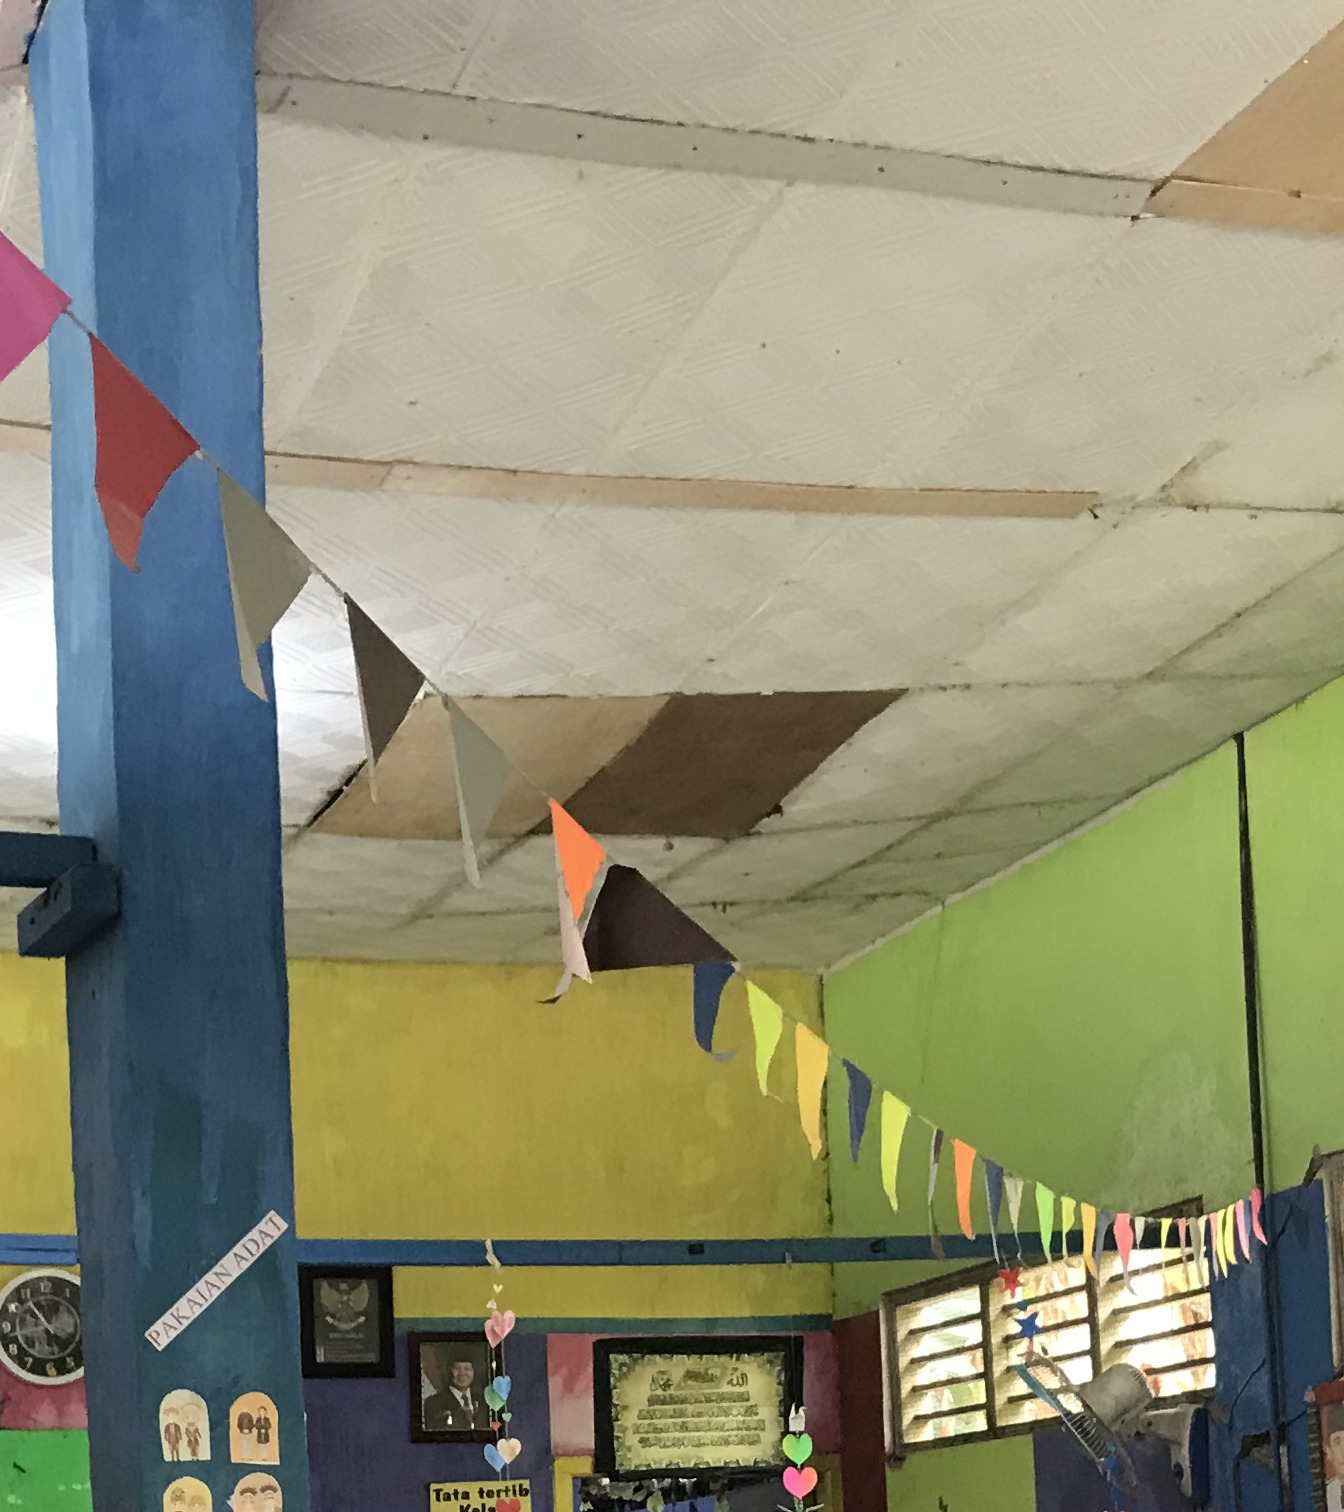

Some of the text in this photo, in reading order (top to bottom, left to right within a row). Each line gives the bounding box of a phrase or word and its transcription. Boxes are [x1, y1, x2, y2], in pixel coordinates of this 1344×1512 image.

[147, 1214, 283, 1347] PAKAIAN ADAT
[433, 1483, 530, 1502] Tata tertib
